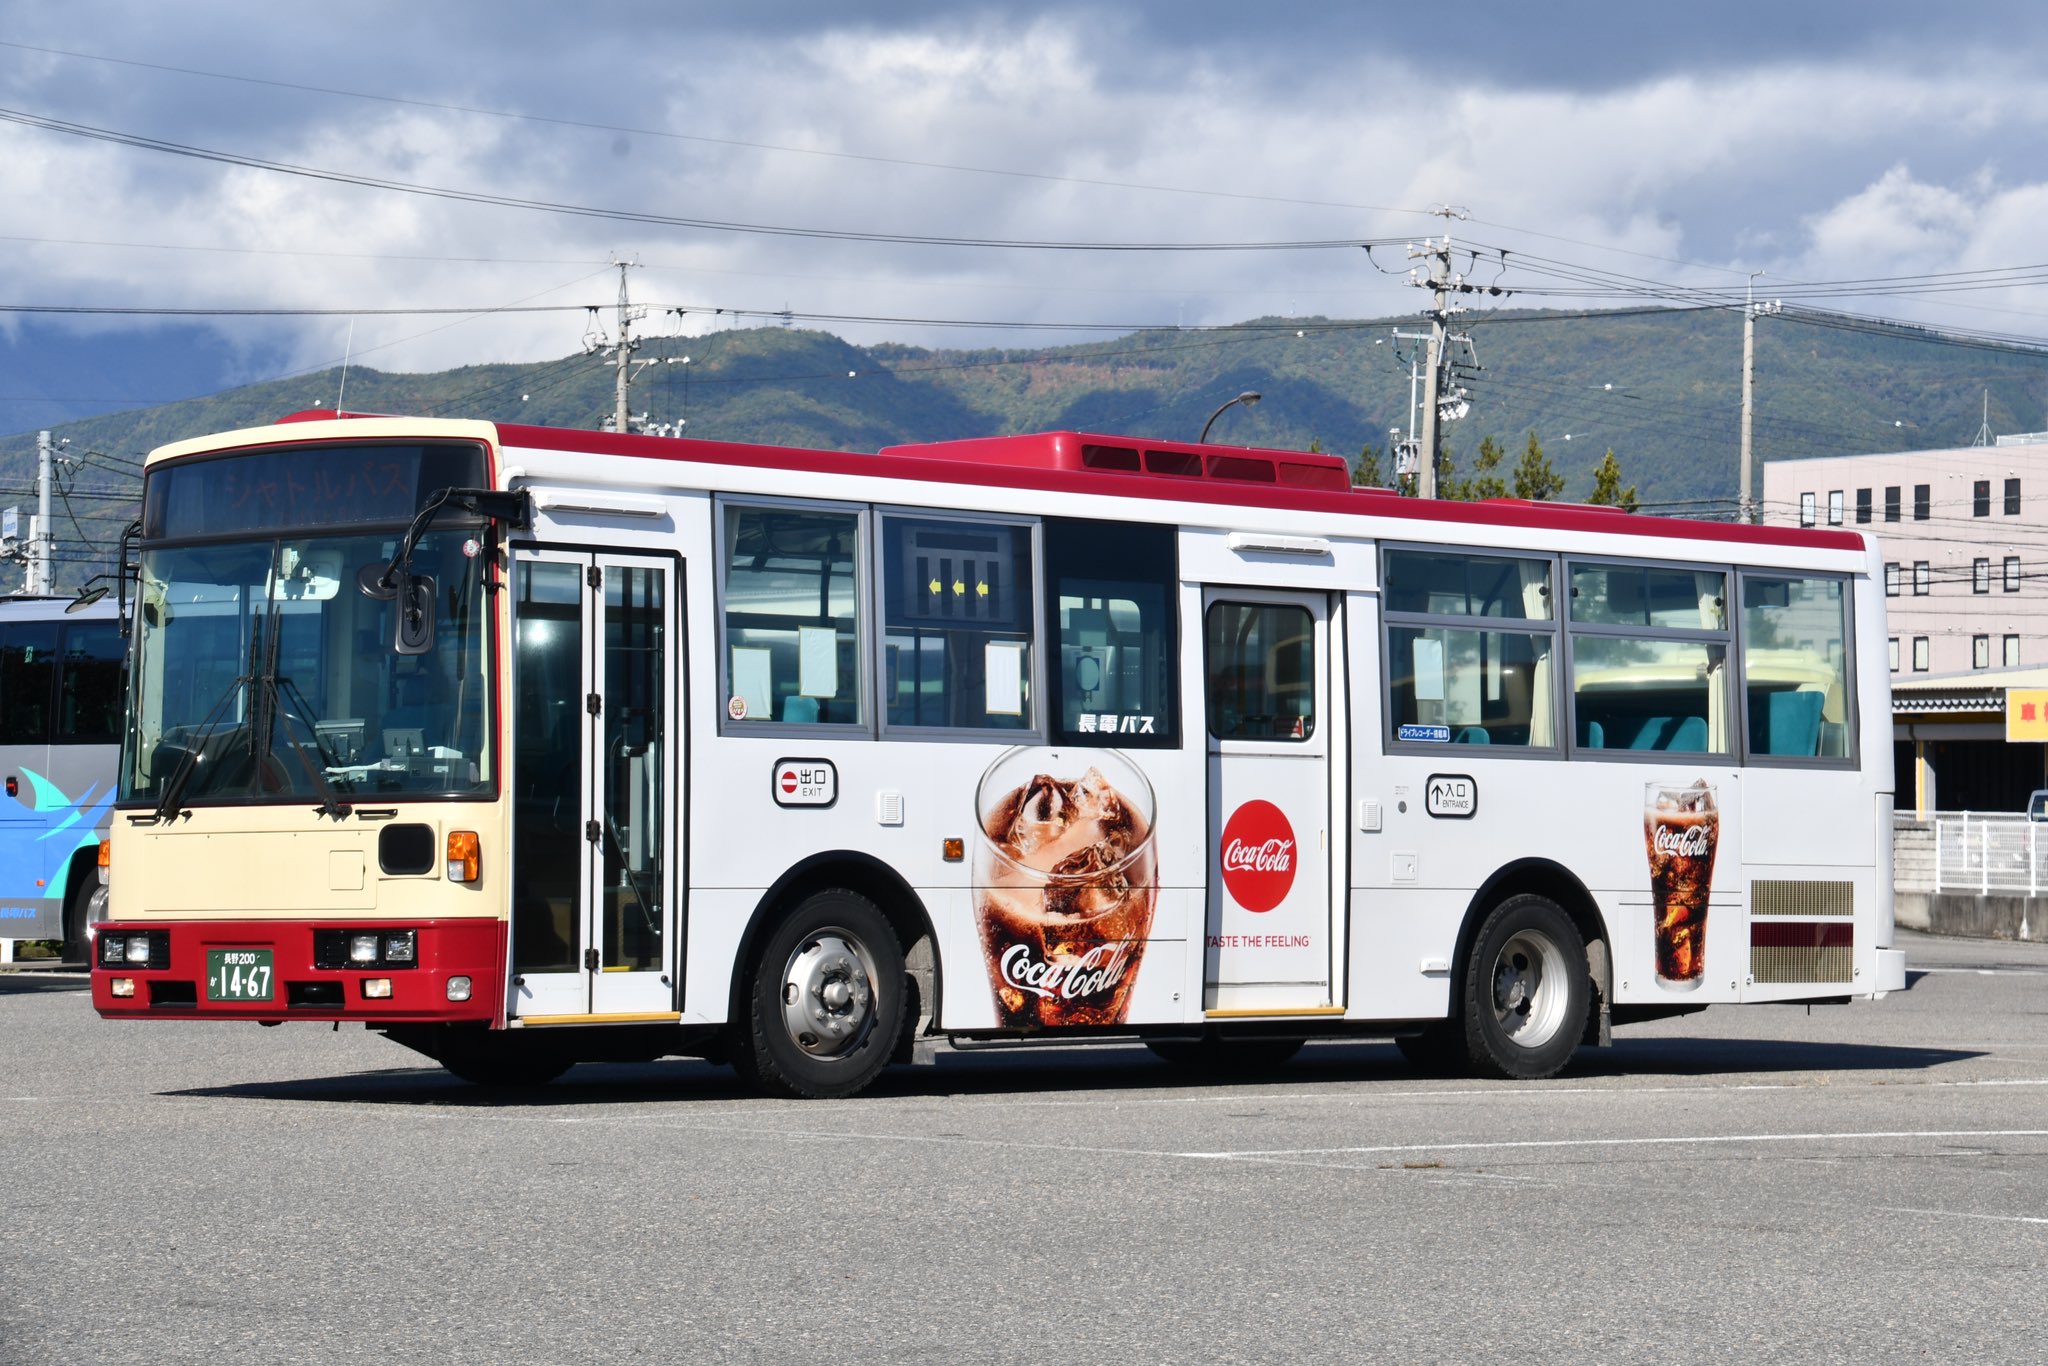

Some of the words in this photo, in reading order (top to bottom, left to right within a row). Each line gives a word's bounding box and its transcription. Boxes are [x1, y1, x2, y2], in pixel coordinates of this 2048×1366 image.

[224, 459, 410, 509] シャトルバス
[2021, 702, 2048, 723] 車
[1079, 713, 1155, 733] 長電バス
[800, 768, 826, 784] 出口
[802, 787, 823, 797] EXIT
[1445, 783, 1465, 798] 入口
[1442, 799, 1469, 809] ENTRANCE
[1655, 824, 1710, 857] Coca-Cola
[1224, 838, 1293, 872] Coca-Cola
[1206, 935, 1239, 948] TASTE
[1242, 935, 1262, 948] THE
[1265, 935, 1309, 948] FEELING
[224, 952, 256, 965] 長野200
[1001, 932, 1131, 999] Coca-Cola
[209, 976, 217, 987] か
[221, 965, 271, 997] 14-67
